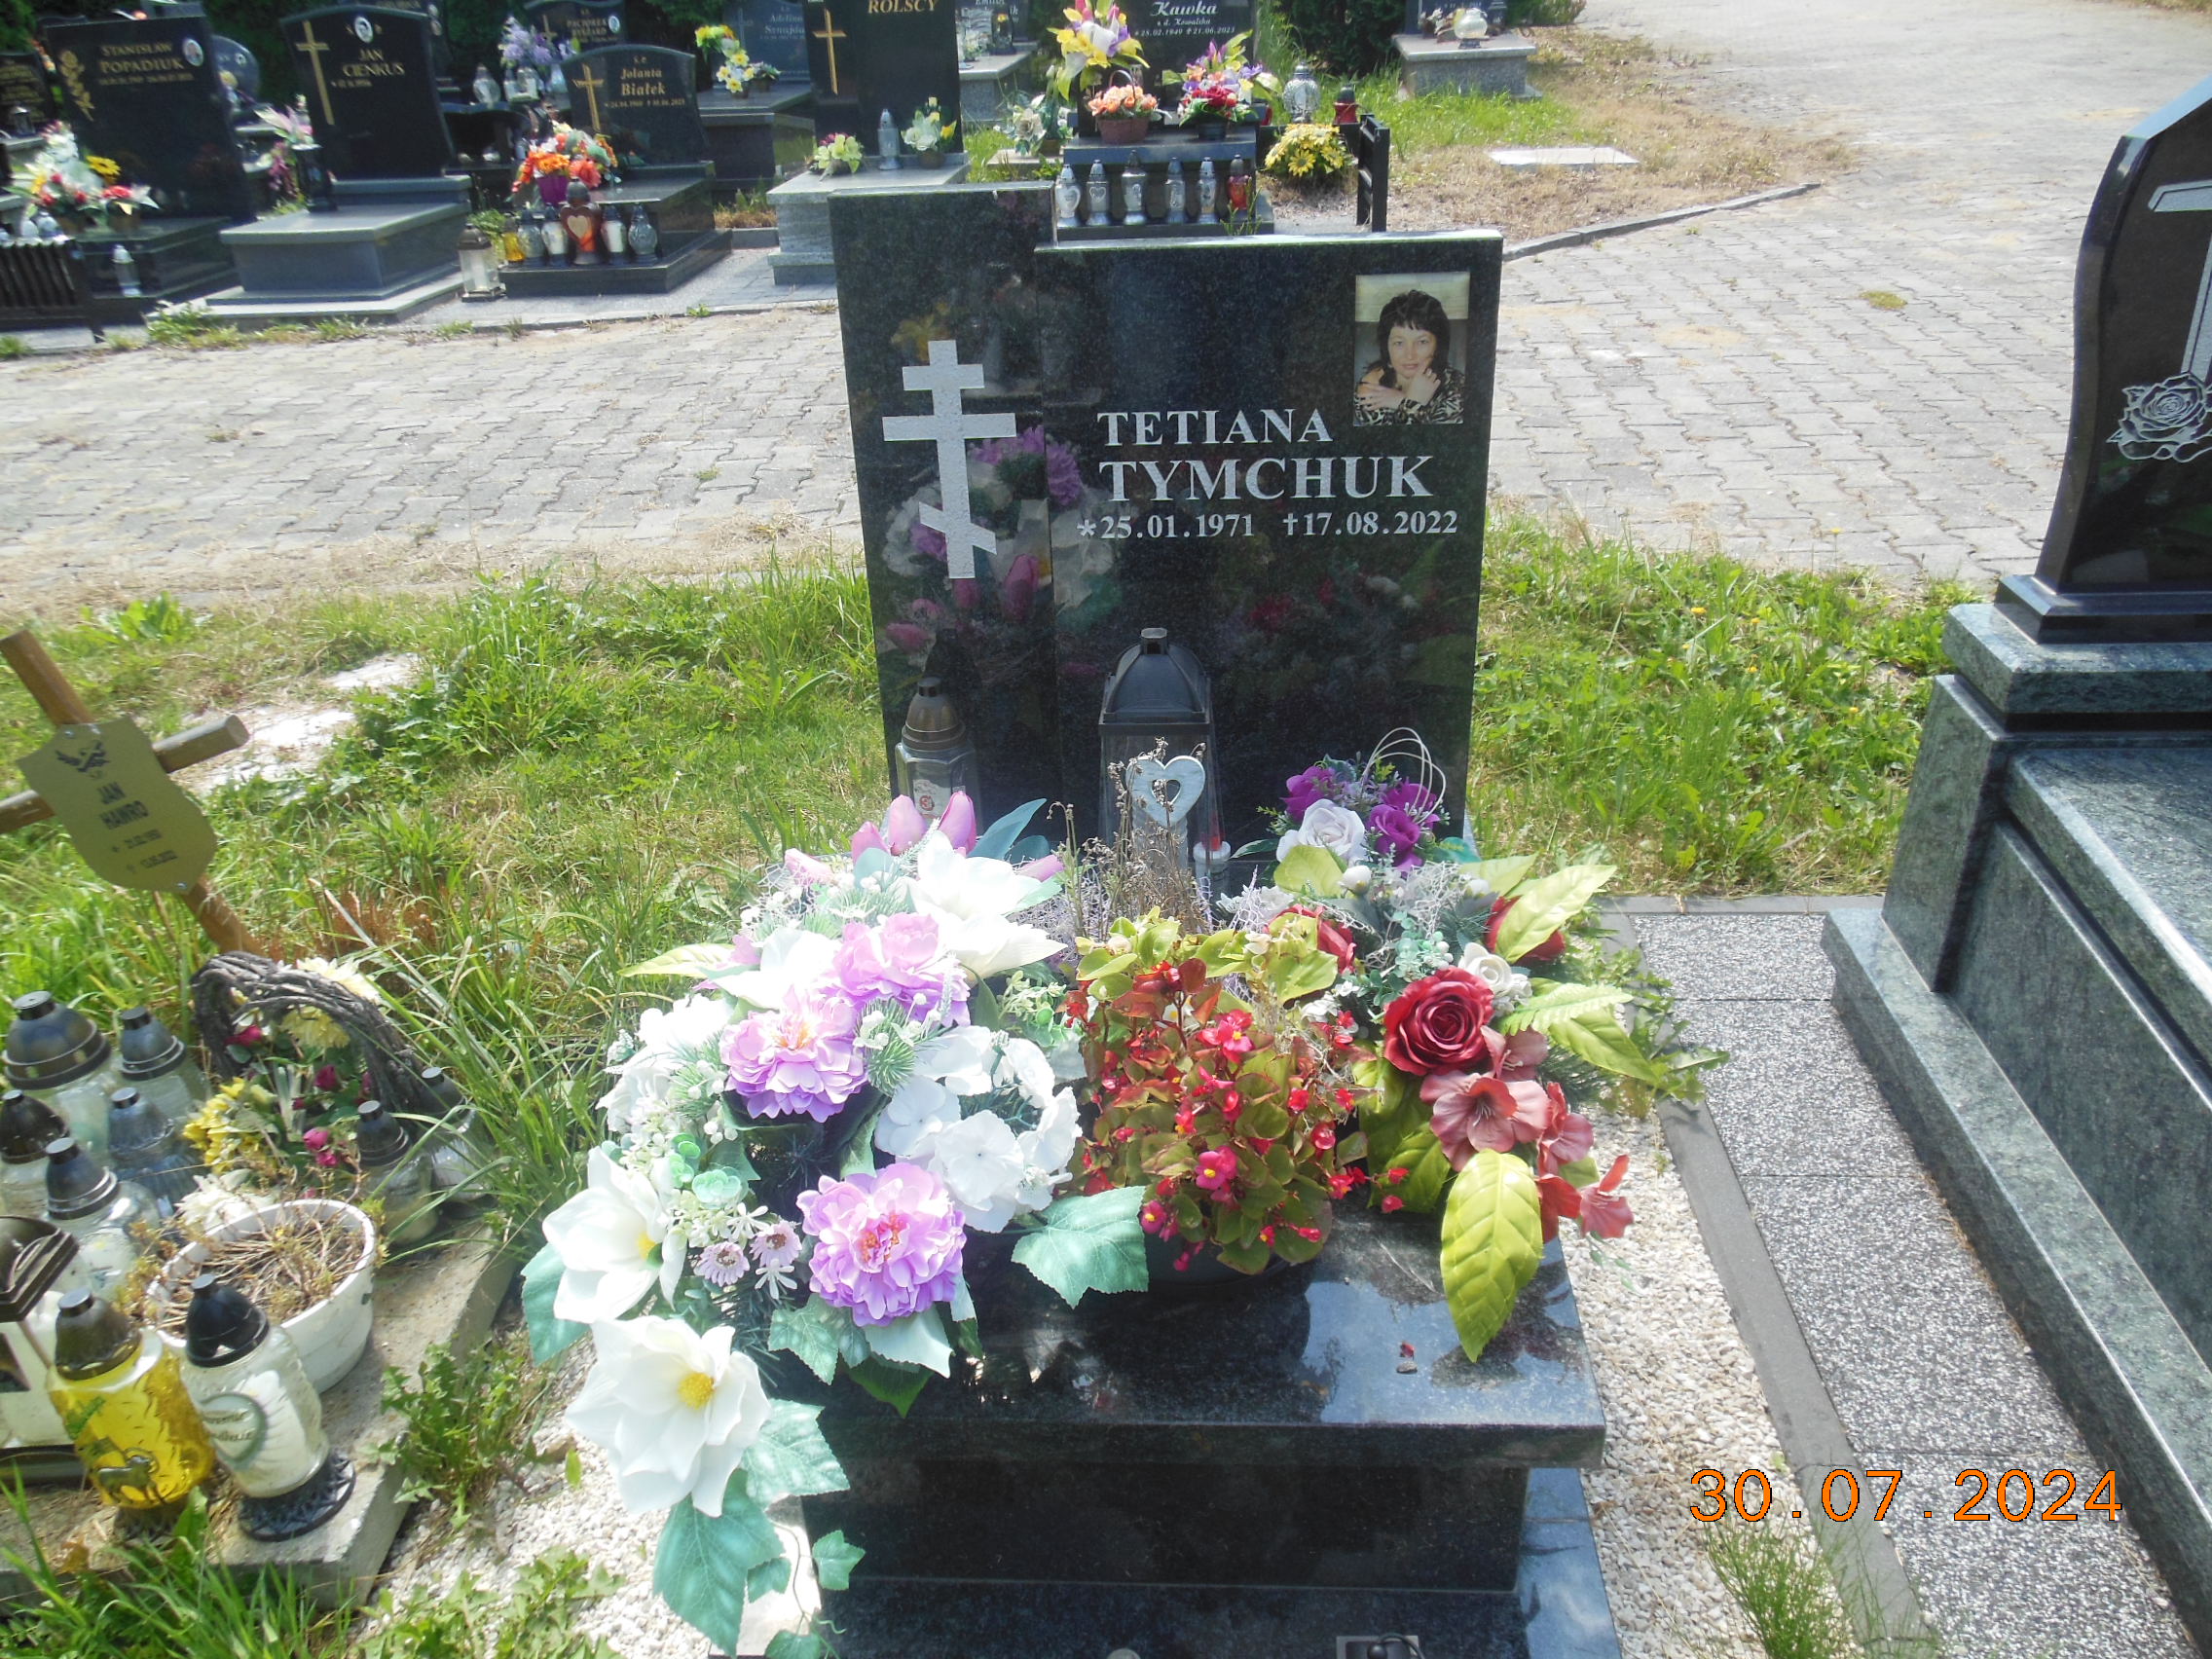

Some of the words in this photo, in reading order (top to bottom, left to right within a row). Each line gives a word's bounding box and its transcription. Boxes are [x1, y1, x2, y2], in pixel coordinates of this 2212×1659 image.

[868, 0, 940, 14] ROLSCY
[1150, 0, 1218, 17] Kawka
[621, 67, 663, 80] Jolanta
[1097, 408, 1333, 447] TETIANA
[1099, 456, 1434, 501] TYMCHUK
